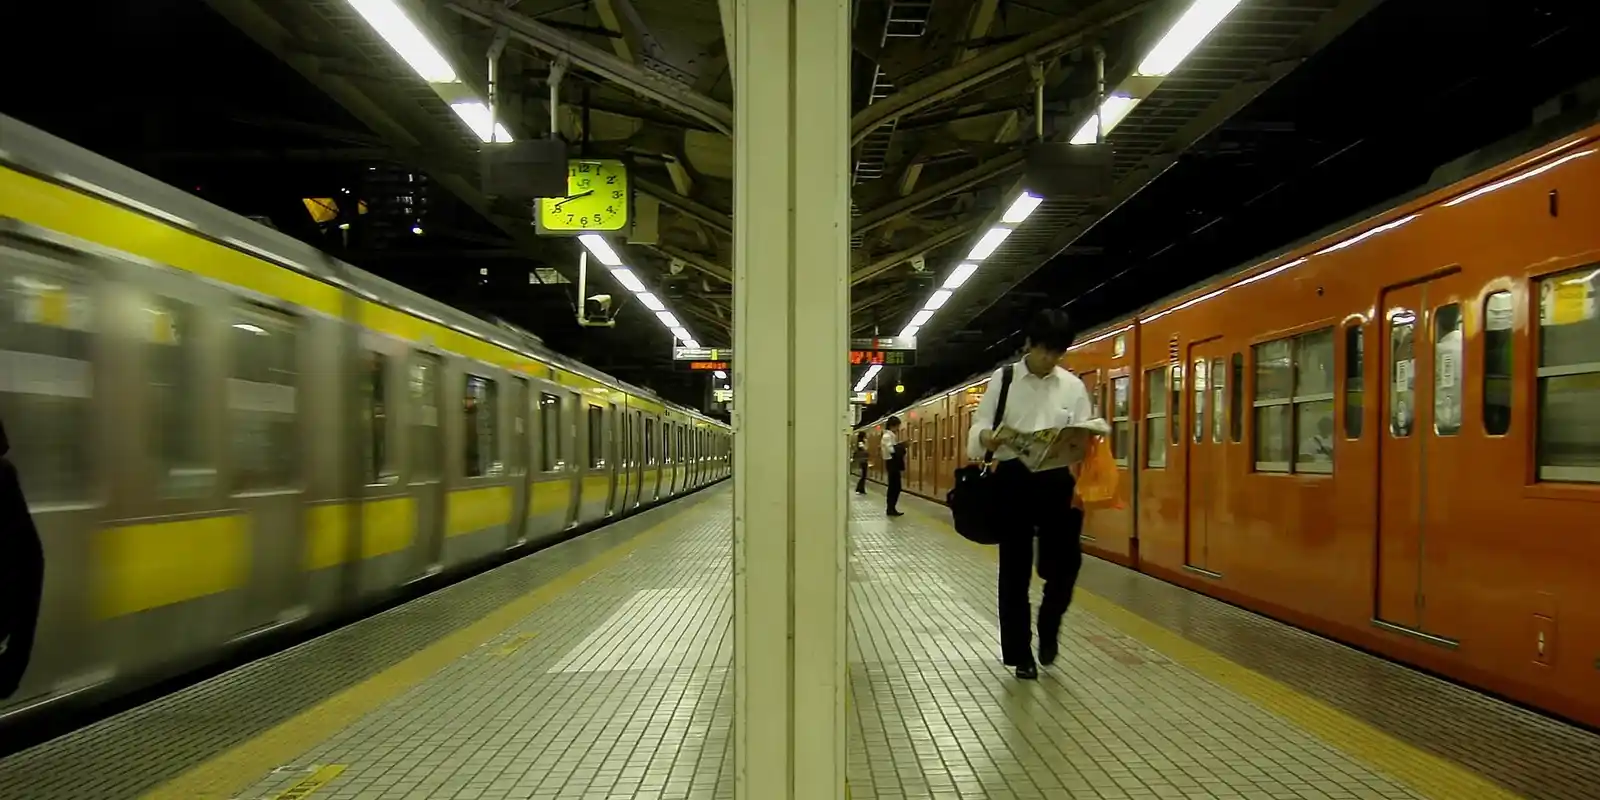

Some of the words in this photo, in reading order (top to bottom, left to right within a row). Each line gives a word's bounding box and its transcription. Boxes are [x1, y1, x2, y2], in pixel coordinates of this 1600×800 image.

[579, 164, 590, 173] 12
[596, 166, 600, 176] 1
[606, 176, 614, 185] 2
[612, 190, 619, 199] 3
[555, 205, 562, 213] 8
[606, 205, 613, 214] 4
[567, 214, 574, 222] 7
[580, 217, 588, 225] 6
[594, 214, 601, 222] 5
